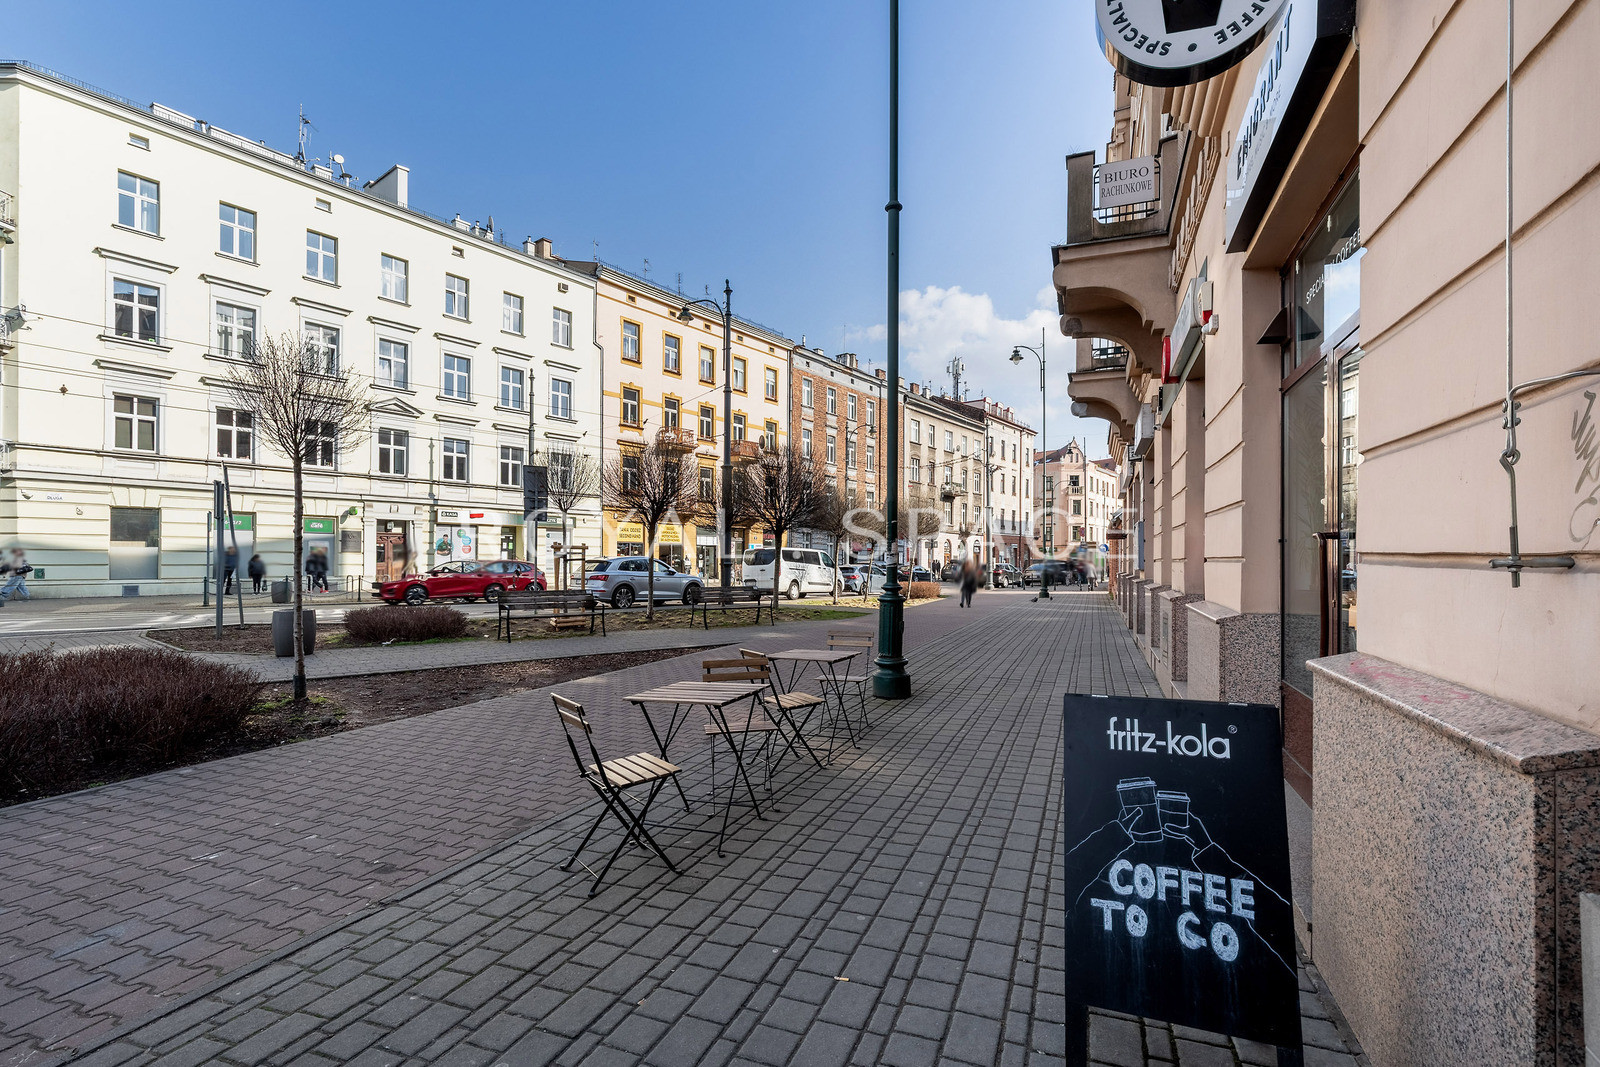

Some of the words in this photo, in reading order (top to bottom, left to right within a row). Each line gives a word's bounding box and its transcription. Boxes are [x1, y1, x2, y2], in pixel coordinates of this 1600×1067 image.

[1213, 0, 1270, 45] OFFEE
[1101, 179, 1153, 198] RACHUNKOWE
[1104, 166, 1149, 184] BIURO
[1108, 858, 1255, 921] COFFEE
[1090, 897, 1149, 938] TO
